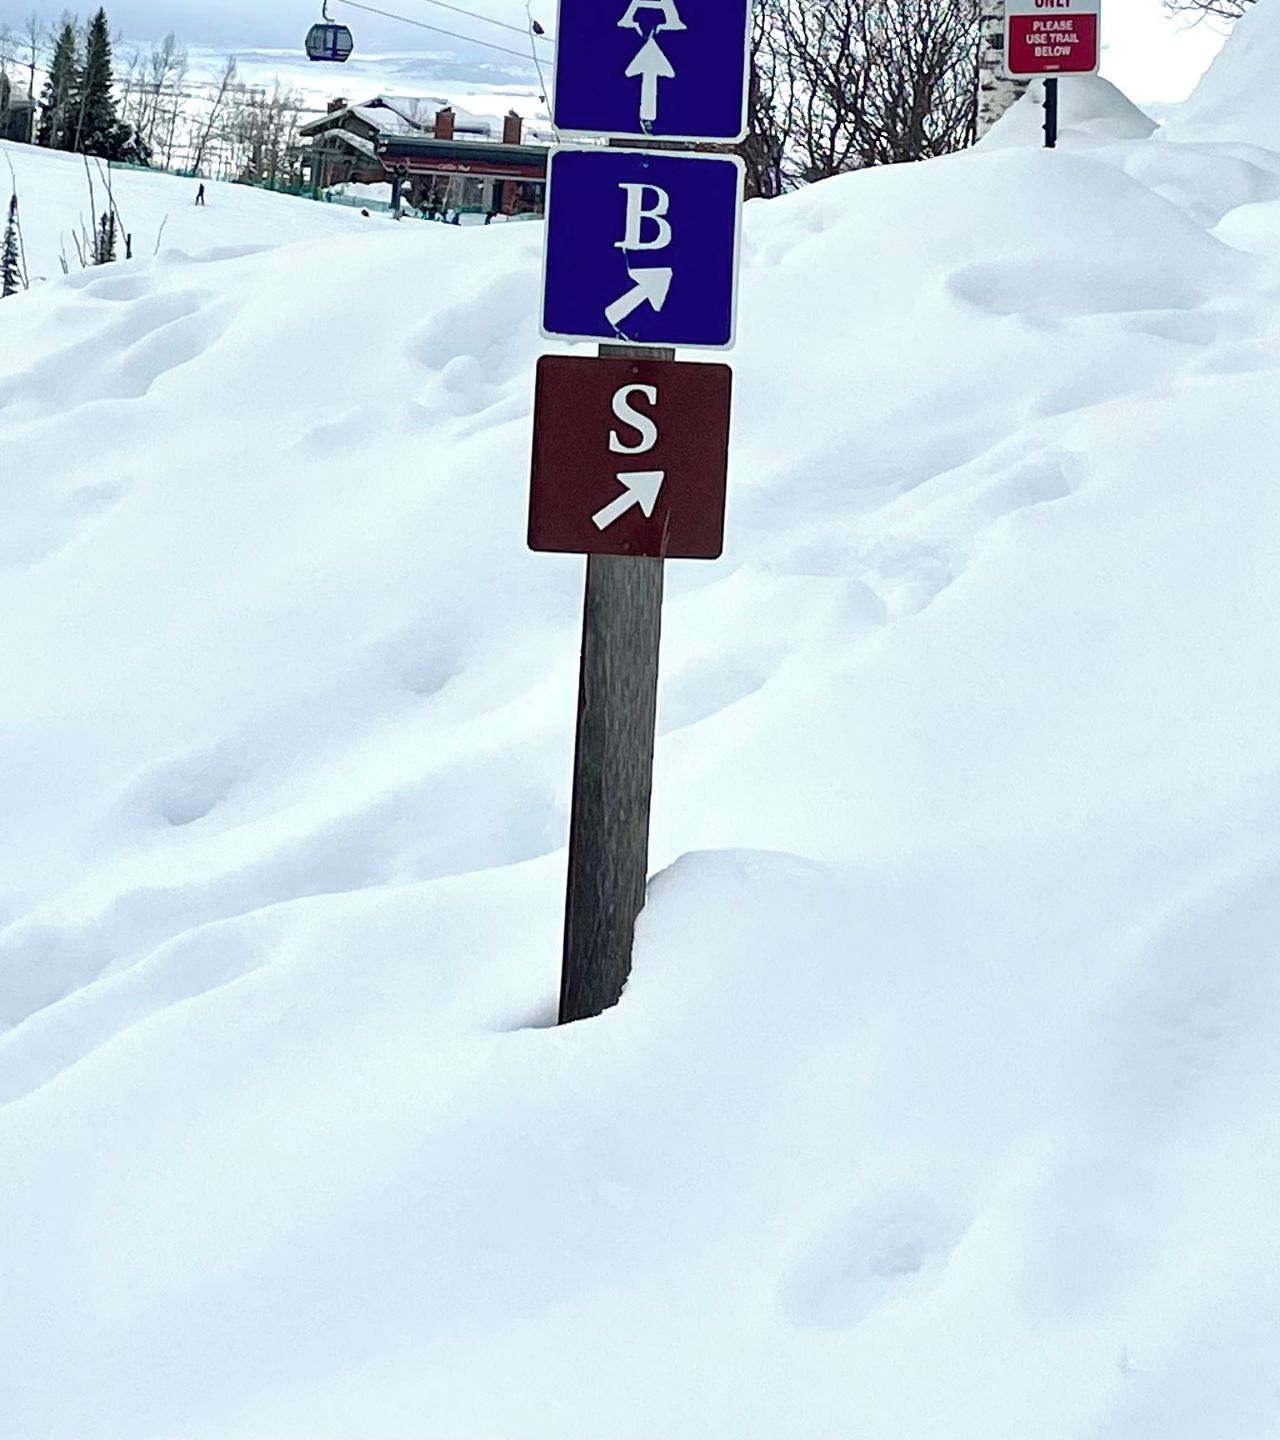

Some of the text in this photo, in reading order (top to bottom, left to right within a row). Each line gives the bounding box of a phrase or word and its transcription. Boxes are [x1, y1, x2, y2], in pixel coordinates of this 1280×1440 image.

[1033, 20, 1073, 31] PLEASE
[1026, 33, 1079, 44] USE TRAIL
[1034, 46, 1071, 57] BELOW
[613, 182, 672, 251] B
[608, 383, 658, 456] S
